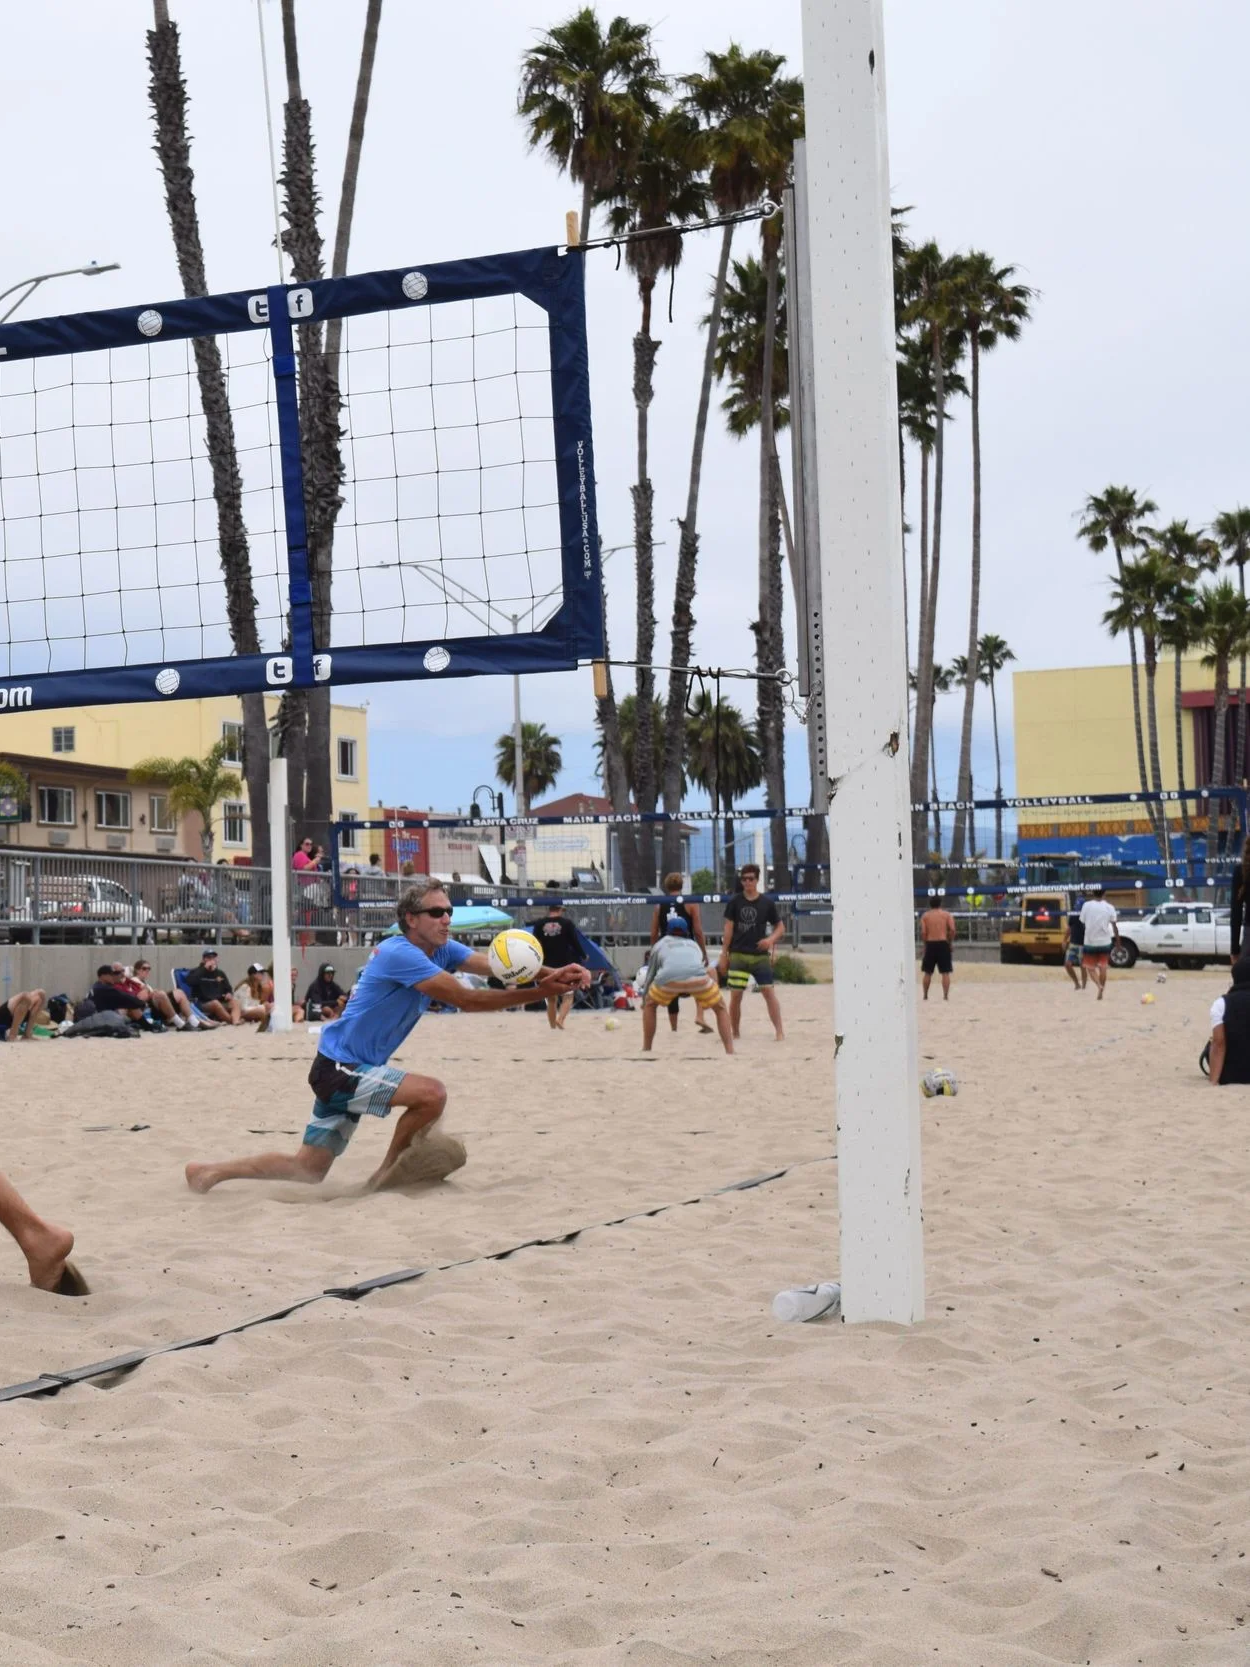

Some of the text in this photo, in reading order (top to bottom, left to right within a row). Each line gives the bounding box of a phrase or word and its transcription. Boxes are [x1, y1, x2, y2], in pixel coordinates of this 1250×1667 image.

[929, 802, 975, 811] BEACH
[1005, 796, 1093, 807] VOLLEYBALL
[563, 814, 642, 824] MAIN BEACH
[669, 810, 750, 821] VOLLEYBALL
[473, 817, 539, 826] SANTA CRUZ
[502, 966, 528, 979] Wilson
